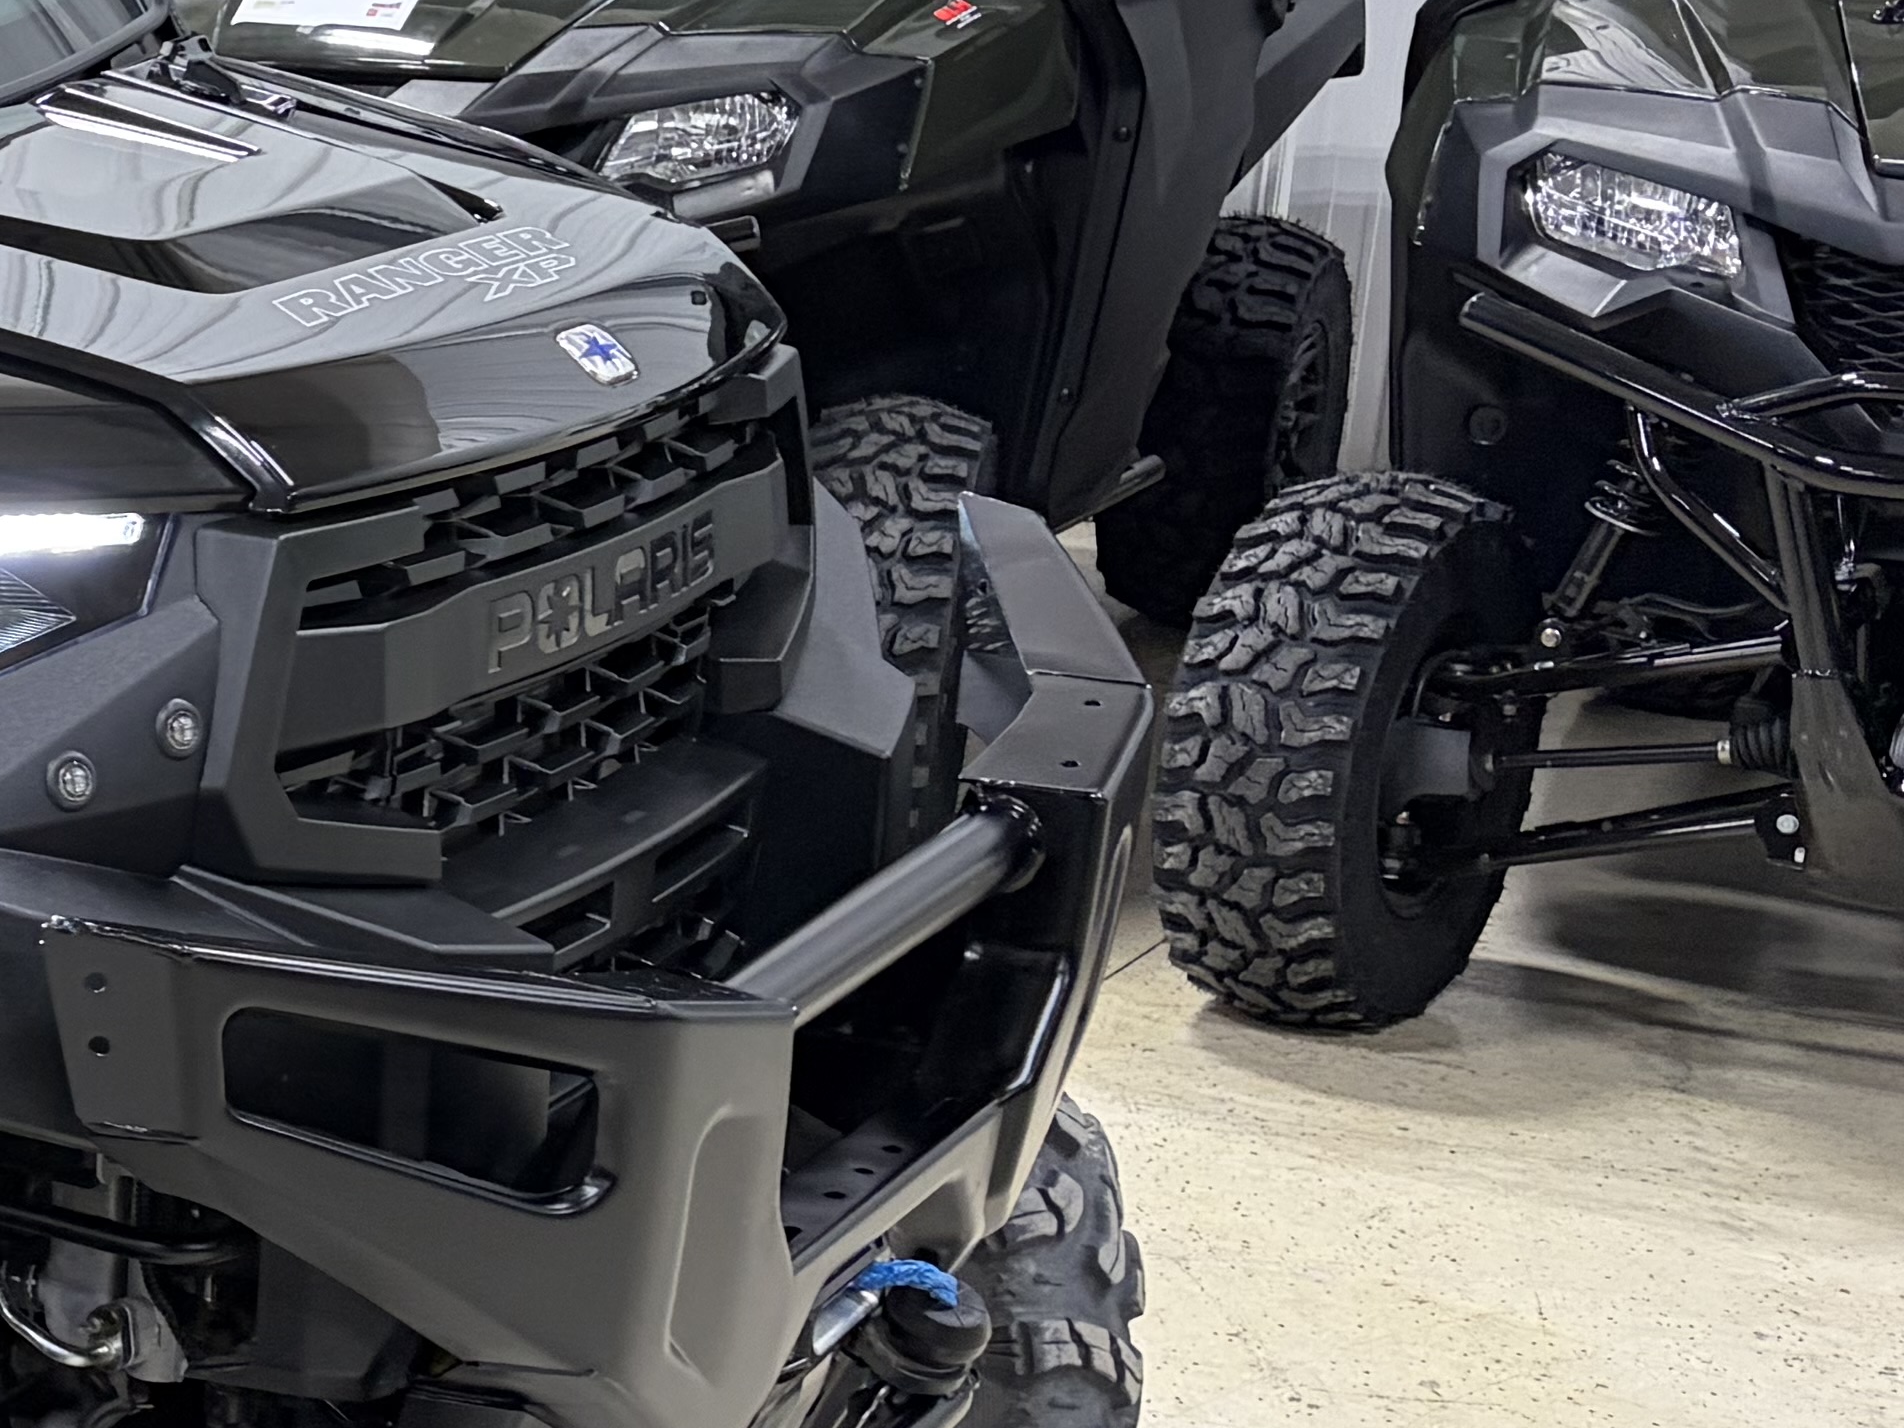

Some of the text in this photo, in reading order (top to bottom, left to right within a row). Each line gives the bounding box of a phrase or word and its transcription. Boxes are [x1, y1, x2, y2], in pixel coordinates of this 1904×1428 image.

[271, 226, 571, 328] RANGER
[466, 254, 577, 302] XP
[487, 509, 715, 673] POLARIS
